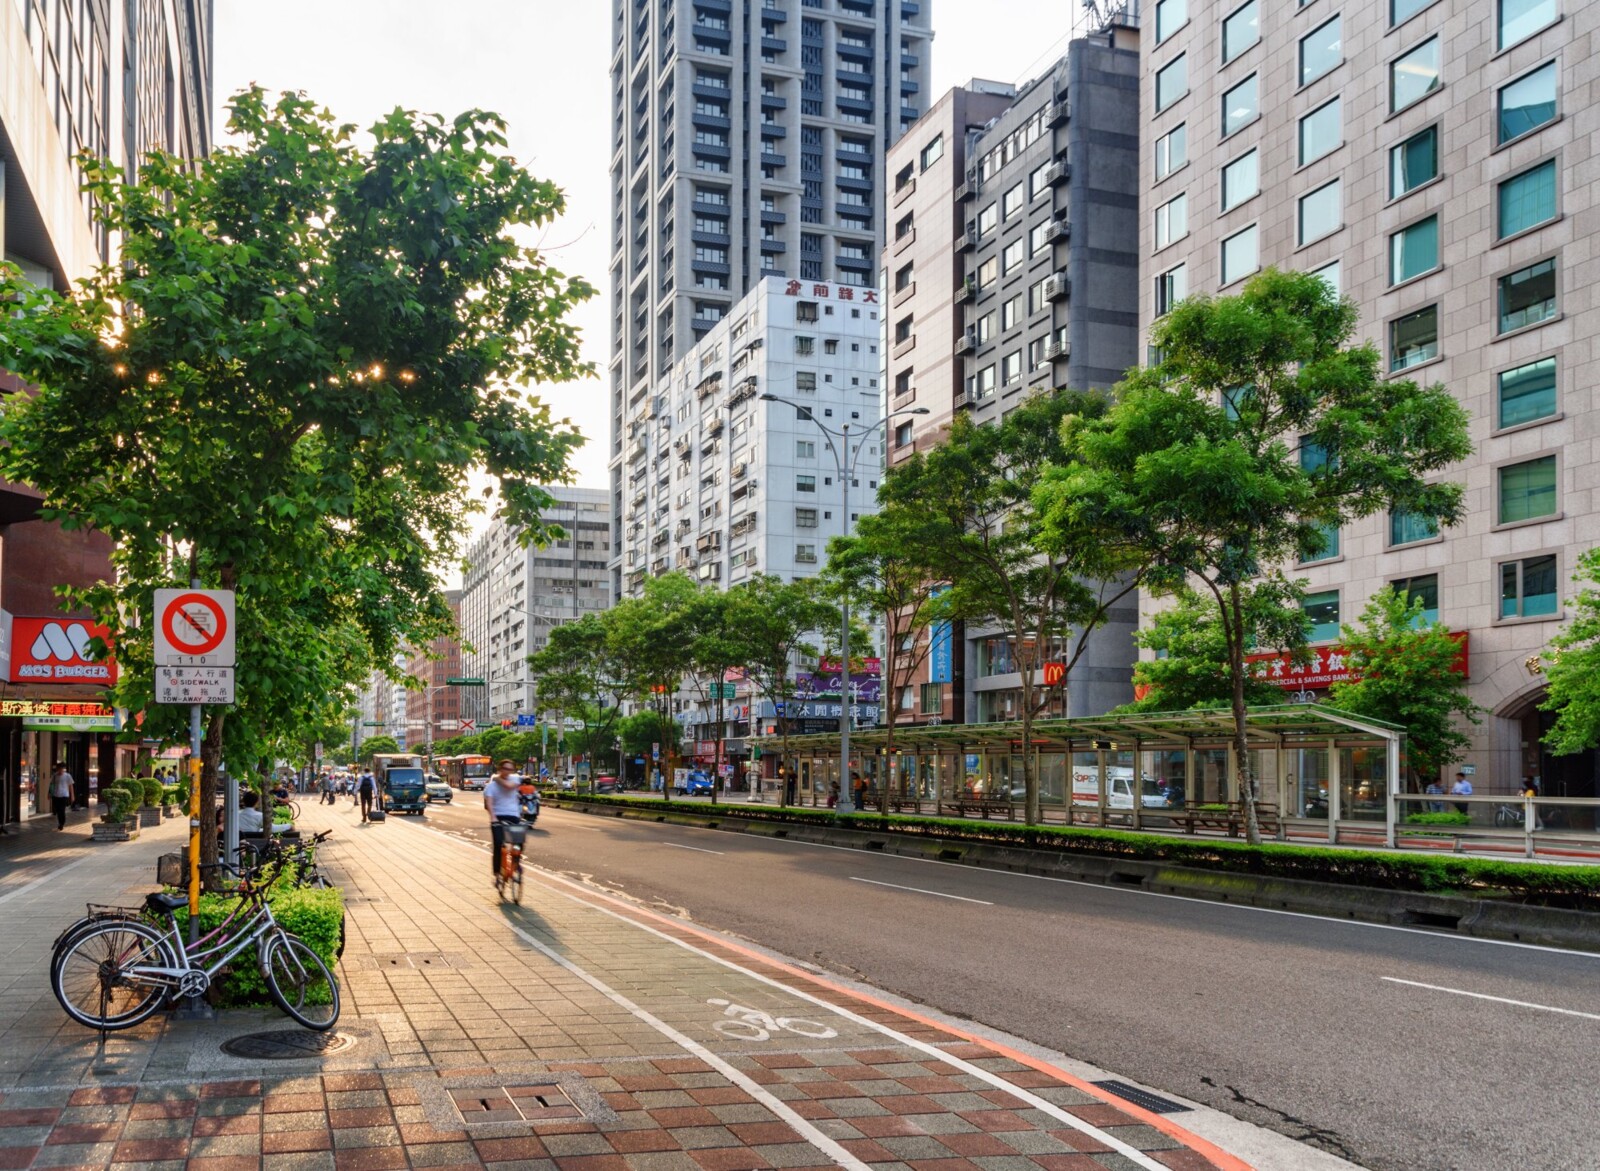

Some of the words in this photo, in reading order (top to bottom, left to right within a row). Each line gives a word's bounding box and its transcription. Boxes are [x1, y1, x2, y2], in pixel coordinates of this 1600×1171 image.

[18, 664, 52, 678] MOS
[54, 665, 109, 678] BURGER
[1304, 675, 1331, 683] SAVINGS
